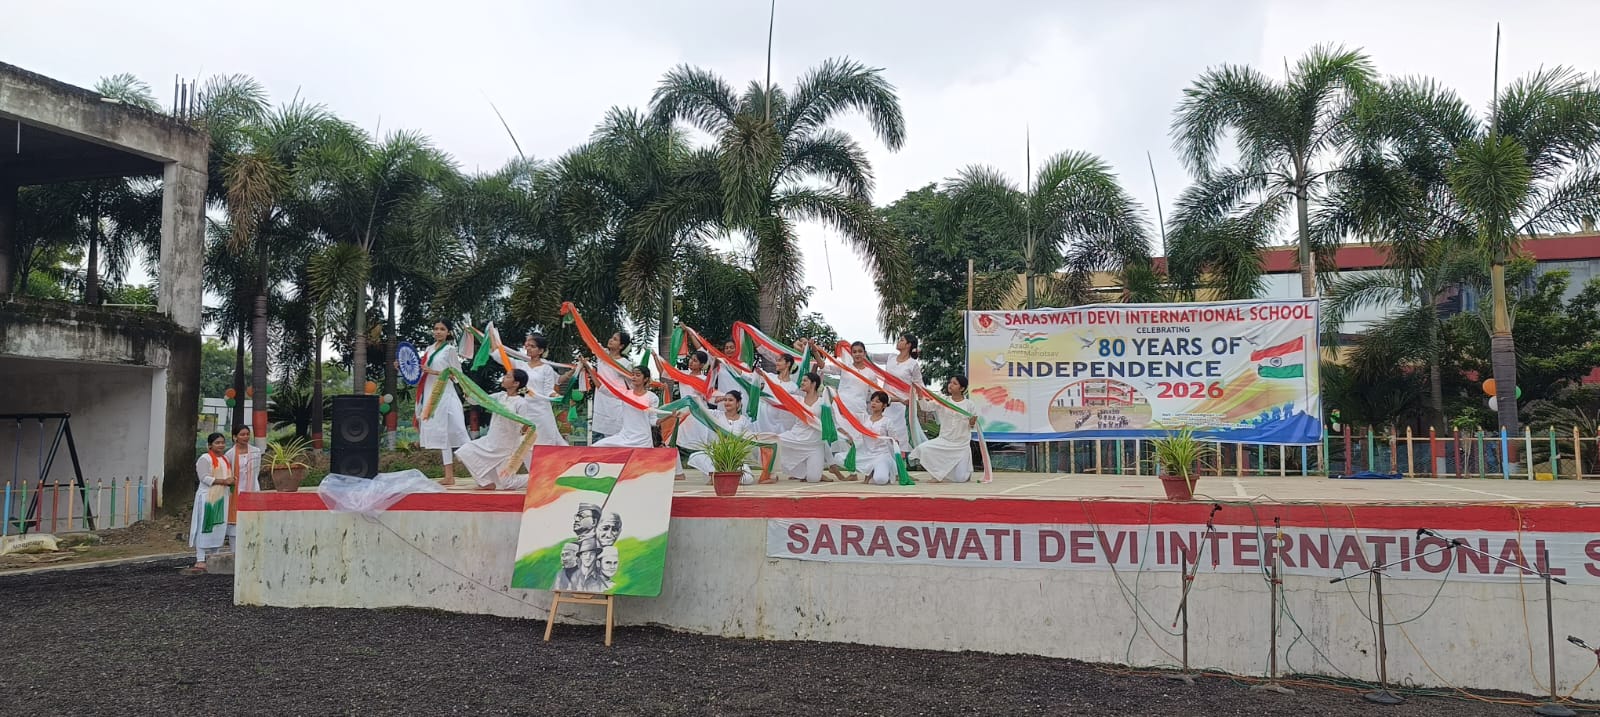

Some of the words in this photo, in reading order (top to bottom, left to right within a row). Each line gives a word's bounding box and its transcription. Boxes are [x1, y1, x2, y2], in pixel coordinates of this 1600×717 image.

[1004, 311, 1082, 326] SARASWATI
[1087, 310, 1120, 325] DEVI
[1125, 307, 1245, 324] INTERNATIONAL
[1250, 305, 1313, 321] SCHOOL
[1136, 326, 1191, 334] CELEBRATING
[1098, 338, 1126, 357] 80
[1132, 337, 1202, 356] YEARS
[1211, 336, 1242, 355] OF
[1008, 360, 1222, 378] INDEPENDENCE
[1157, 381, 1225, 399] 2026
[787, 523, 1022, 562] SARASWATI
[1038, 529, 1139, 565] DEVI
[1156, 531, 1566, 576] INTERNATIONAL
